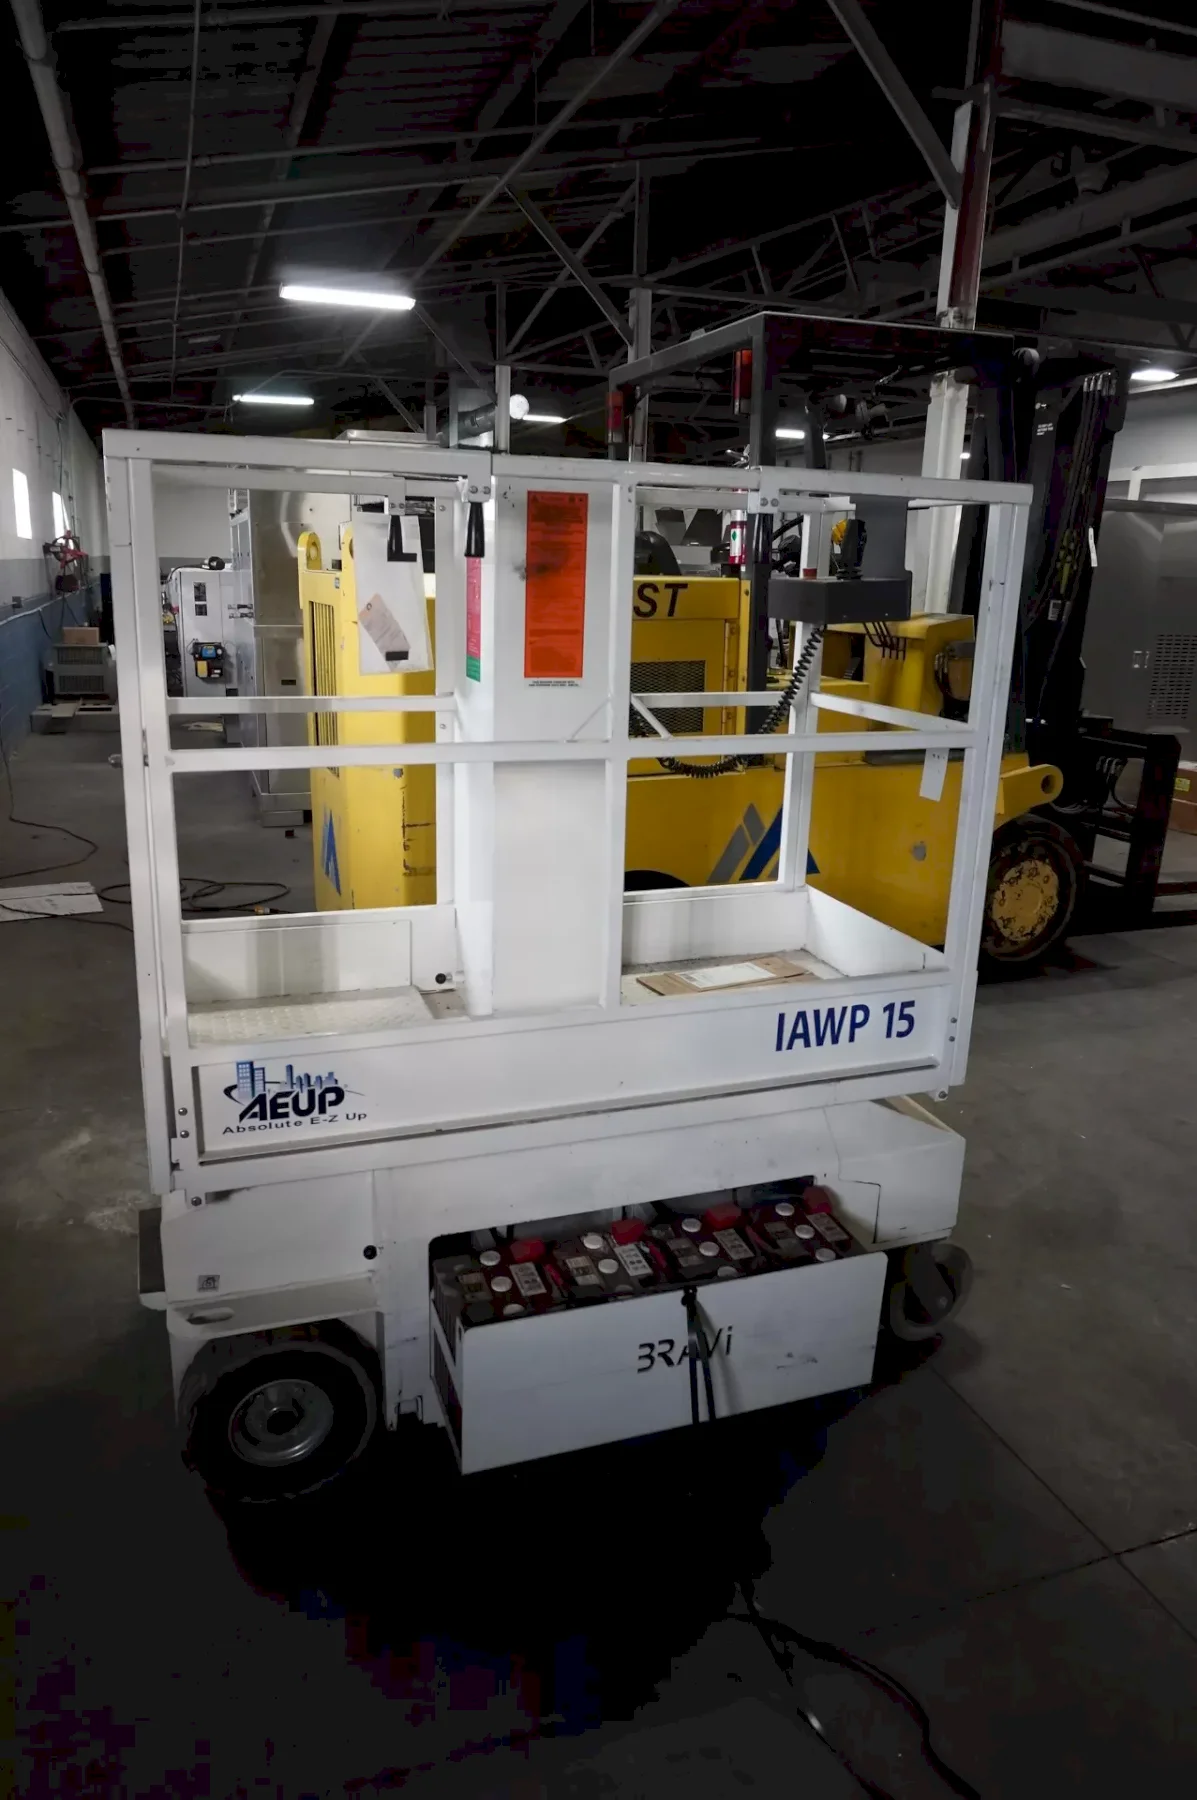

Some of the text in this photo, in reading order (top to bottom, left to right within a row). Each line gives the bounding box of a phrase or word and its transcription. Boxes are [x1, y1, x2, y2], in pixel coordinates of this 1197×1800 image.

[633, 583, 688, 618] ST
[775, 1000, 915, 1052] IAWP 15
[239, 1086, 345, 1124] AEUP
[222, 1112, 367, 1135] Absolute E-Z Up
